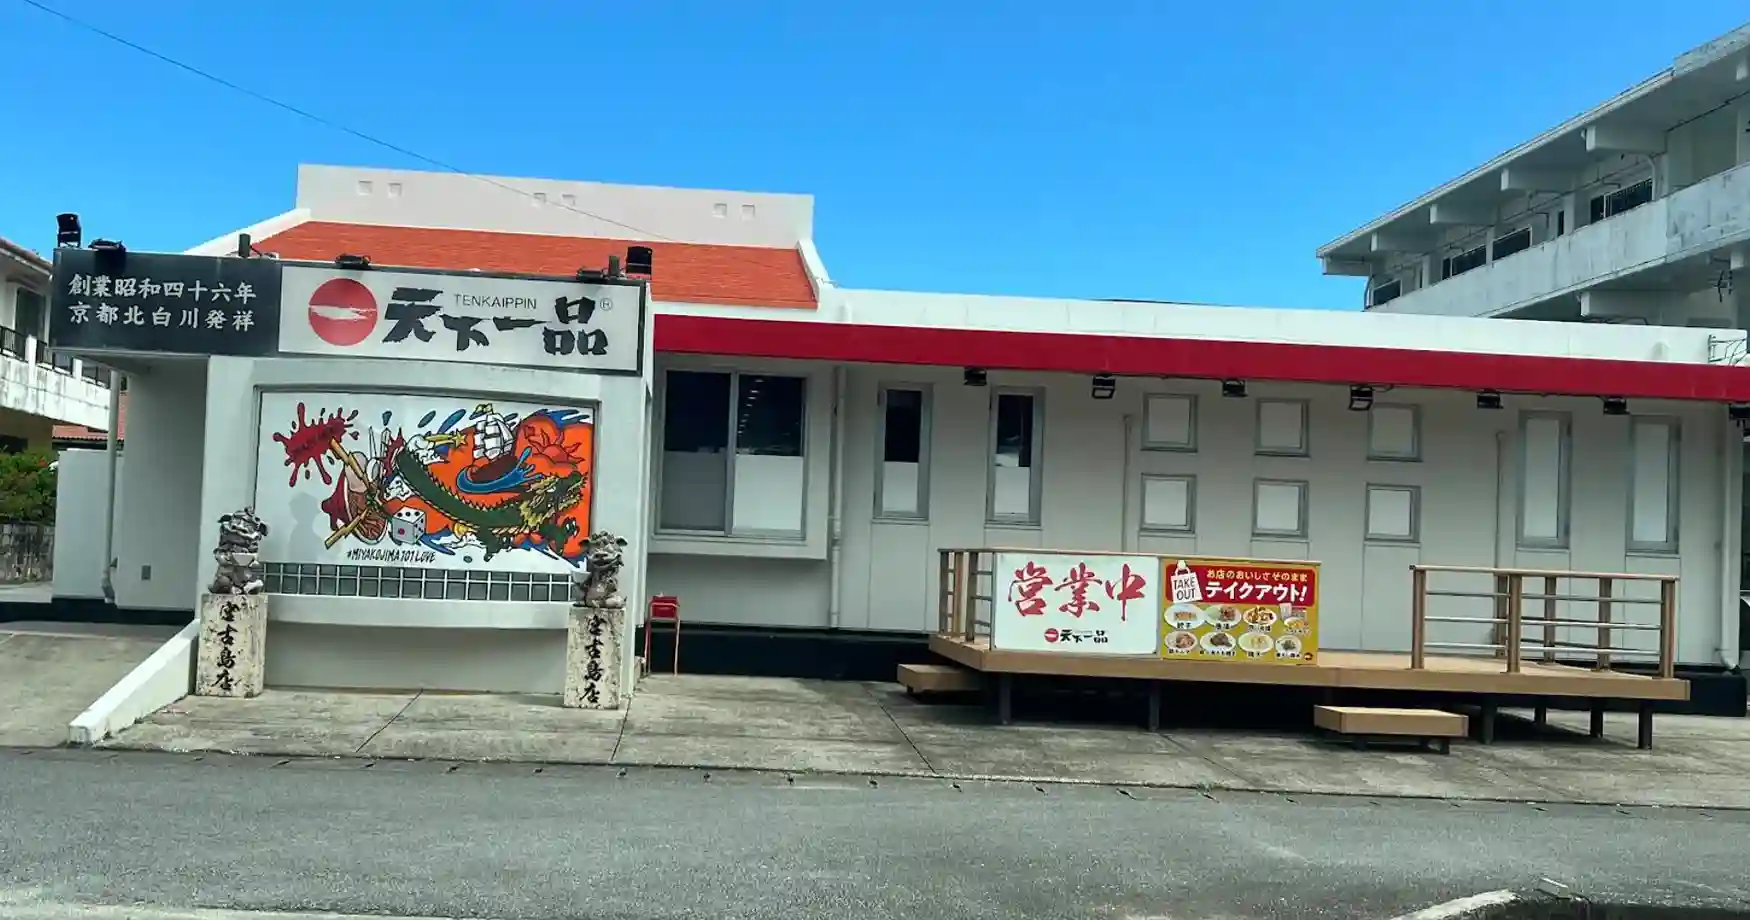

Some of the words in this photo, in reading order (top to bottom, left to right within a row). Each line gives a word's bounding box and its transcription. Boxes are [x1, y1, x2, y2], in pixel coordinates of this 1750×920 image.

[68, 273, 257, 304] 創業昭和四十六年
[454, 293, 537, 310] TENKAIPPIN
[68, 301, 255, 332] 京都北白川発祥
[382, 287, 608, 355] 天下一品
[1008, 561, 1146, 621] 営業中
[1173, 576, 1196, 588] TAKE
[1176, 589, 1196, 601] OUT
[1060, 629, 1109, 643] 天下一品
